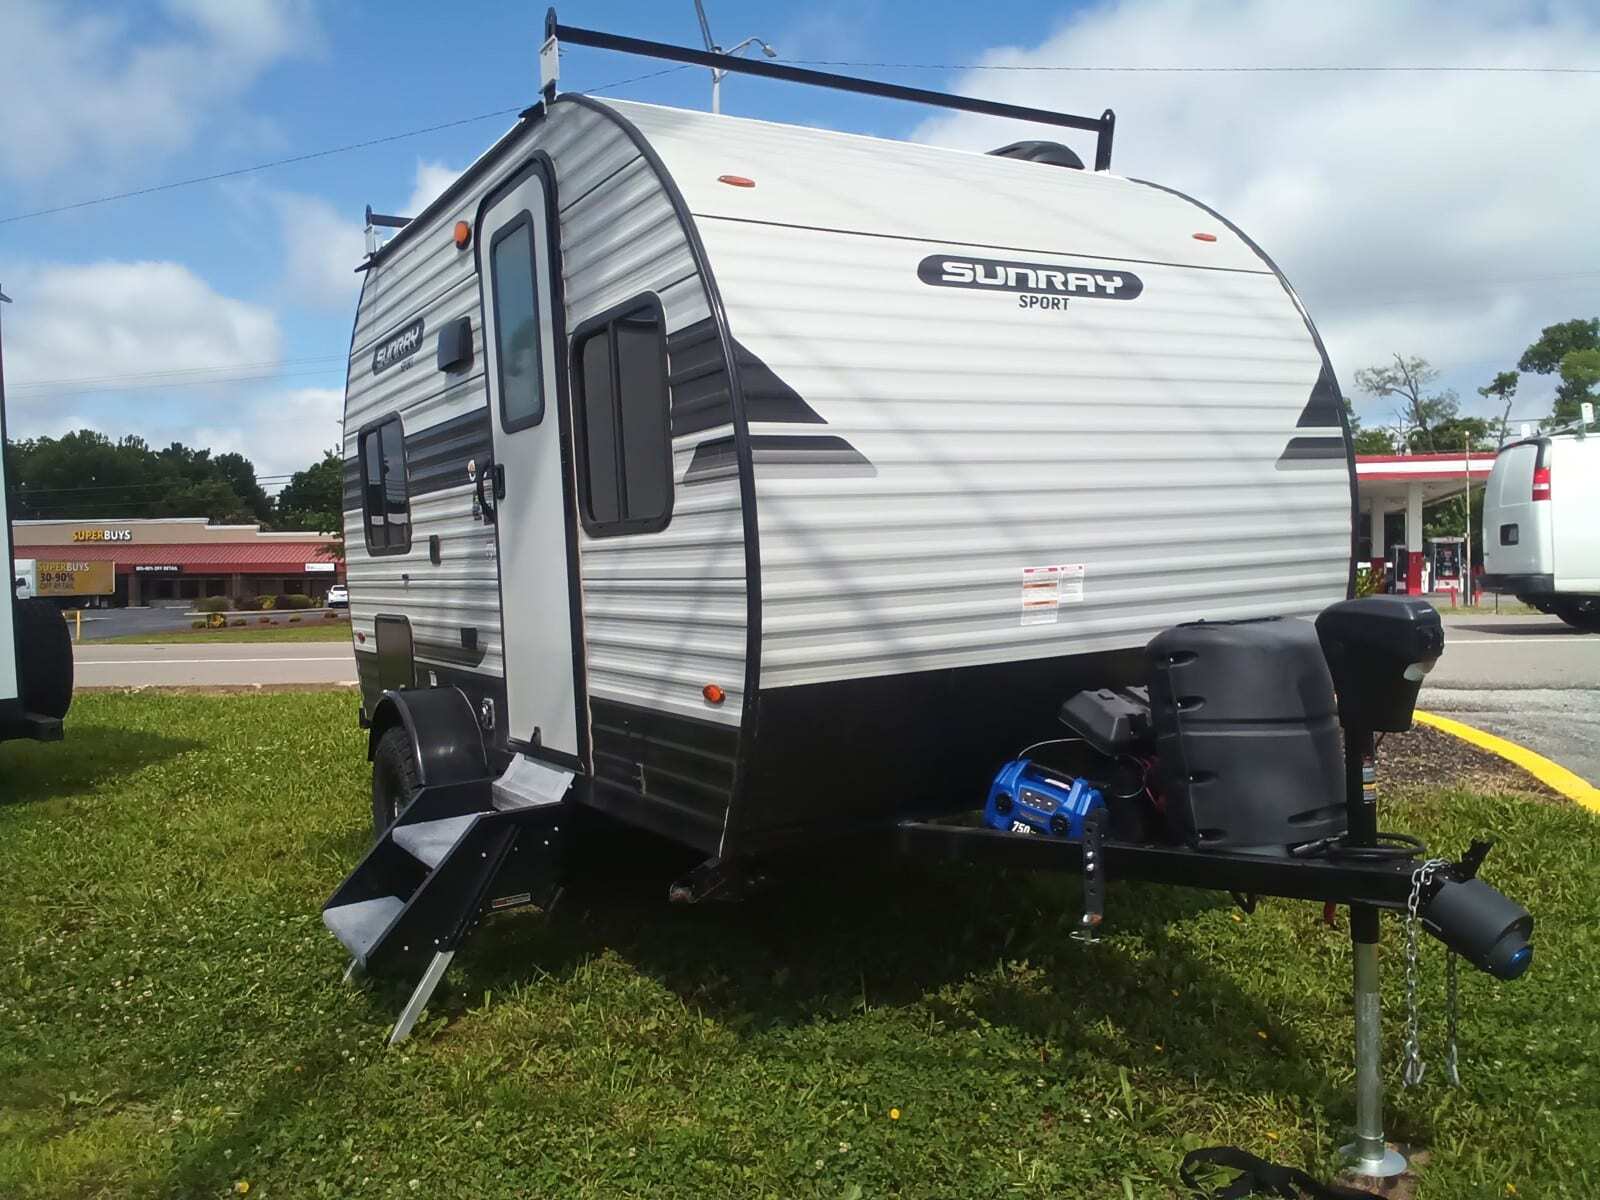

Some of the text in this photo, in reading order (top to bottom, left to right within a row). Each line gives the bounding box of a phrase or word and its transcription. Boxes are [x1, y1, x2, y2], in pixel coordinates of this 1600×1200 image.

[942, 261, 1123, 294] SUNRAY
[1018, 294, 1069, 310] SPORT
[73, 529, 131, 541] SUPERBUYS
[1012, 820, 1031, 833] 750
